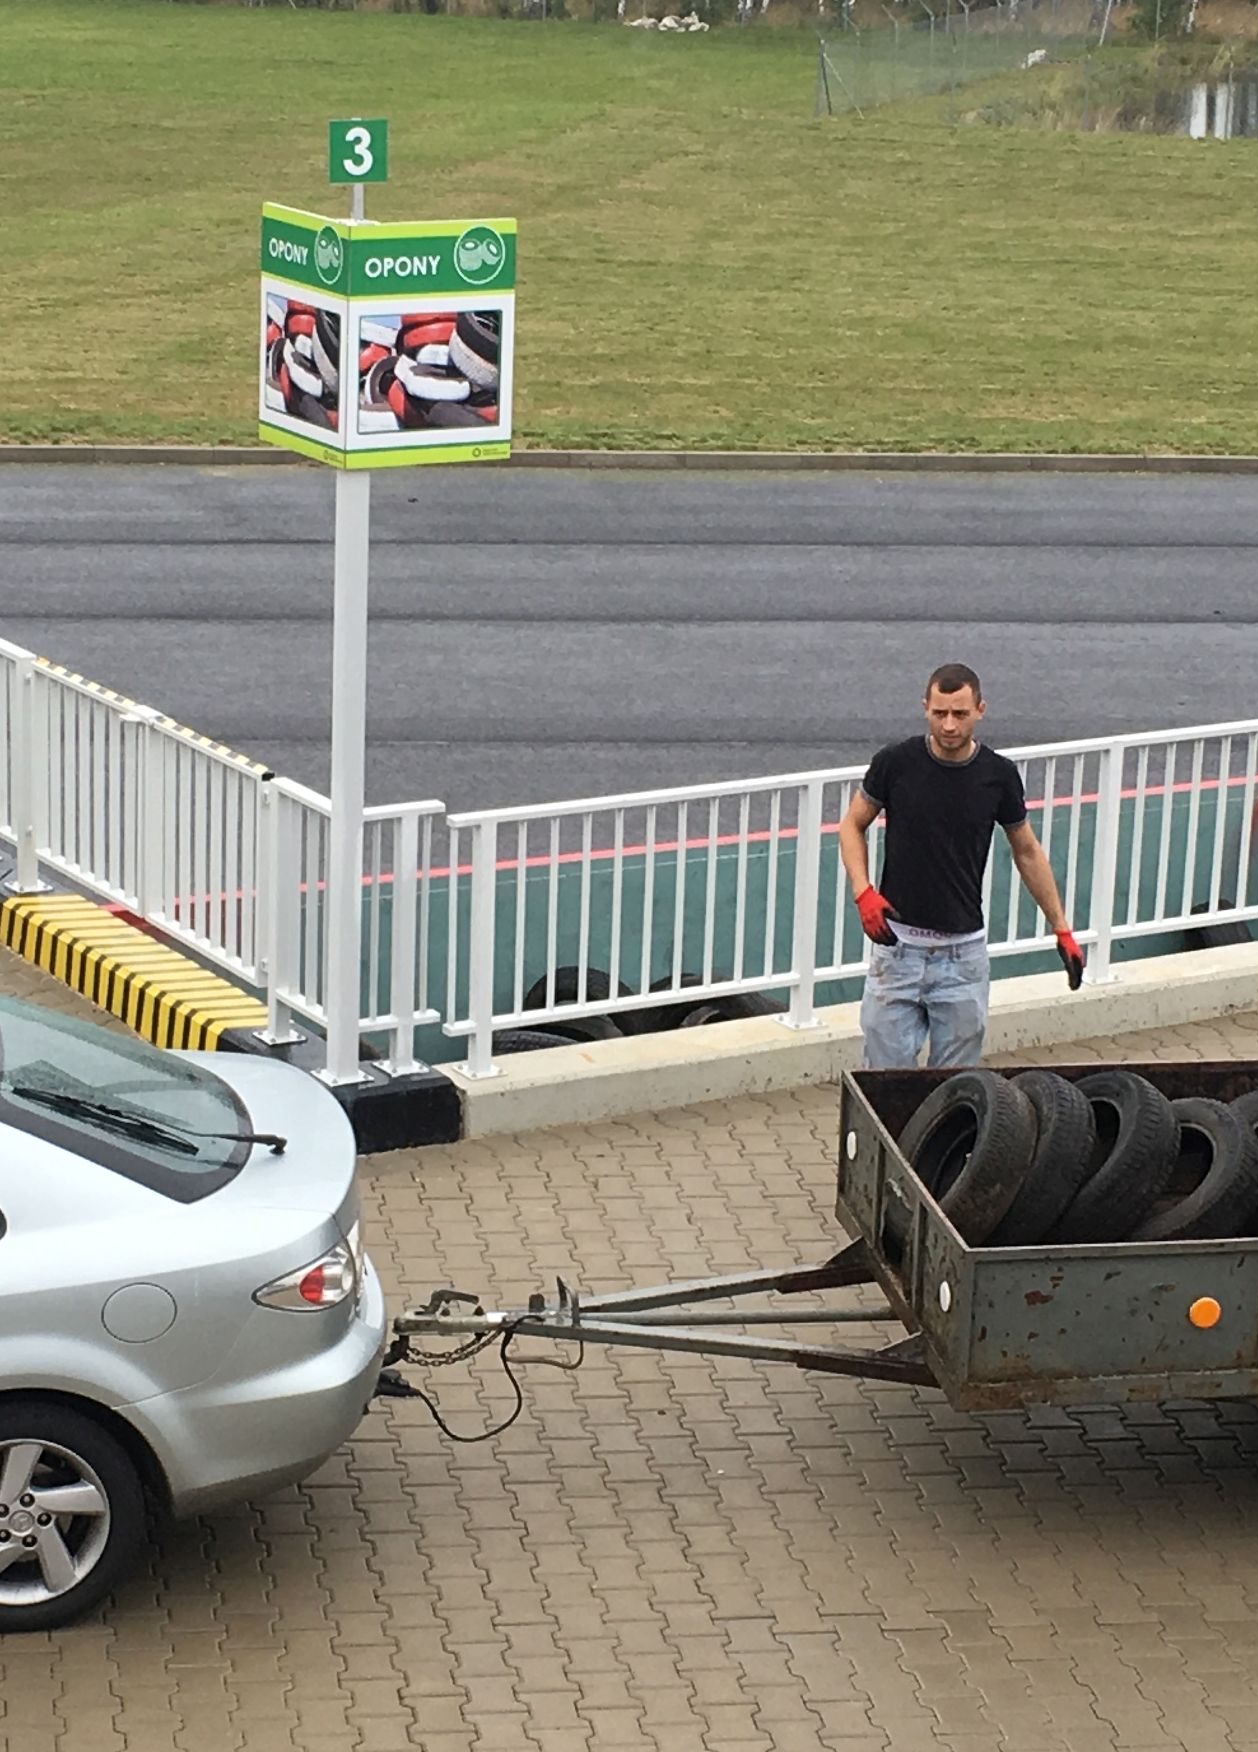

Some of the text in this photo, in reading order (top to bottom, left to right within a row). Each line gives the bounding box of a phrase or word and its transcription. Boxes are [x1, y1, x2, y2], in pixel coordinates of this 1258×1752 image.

[343, 127, 373, 176] 3
[269, 237, 308, 266] OPONY
[365, 255, 441, 278] OPONY
